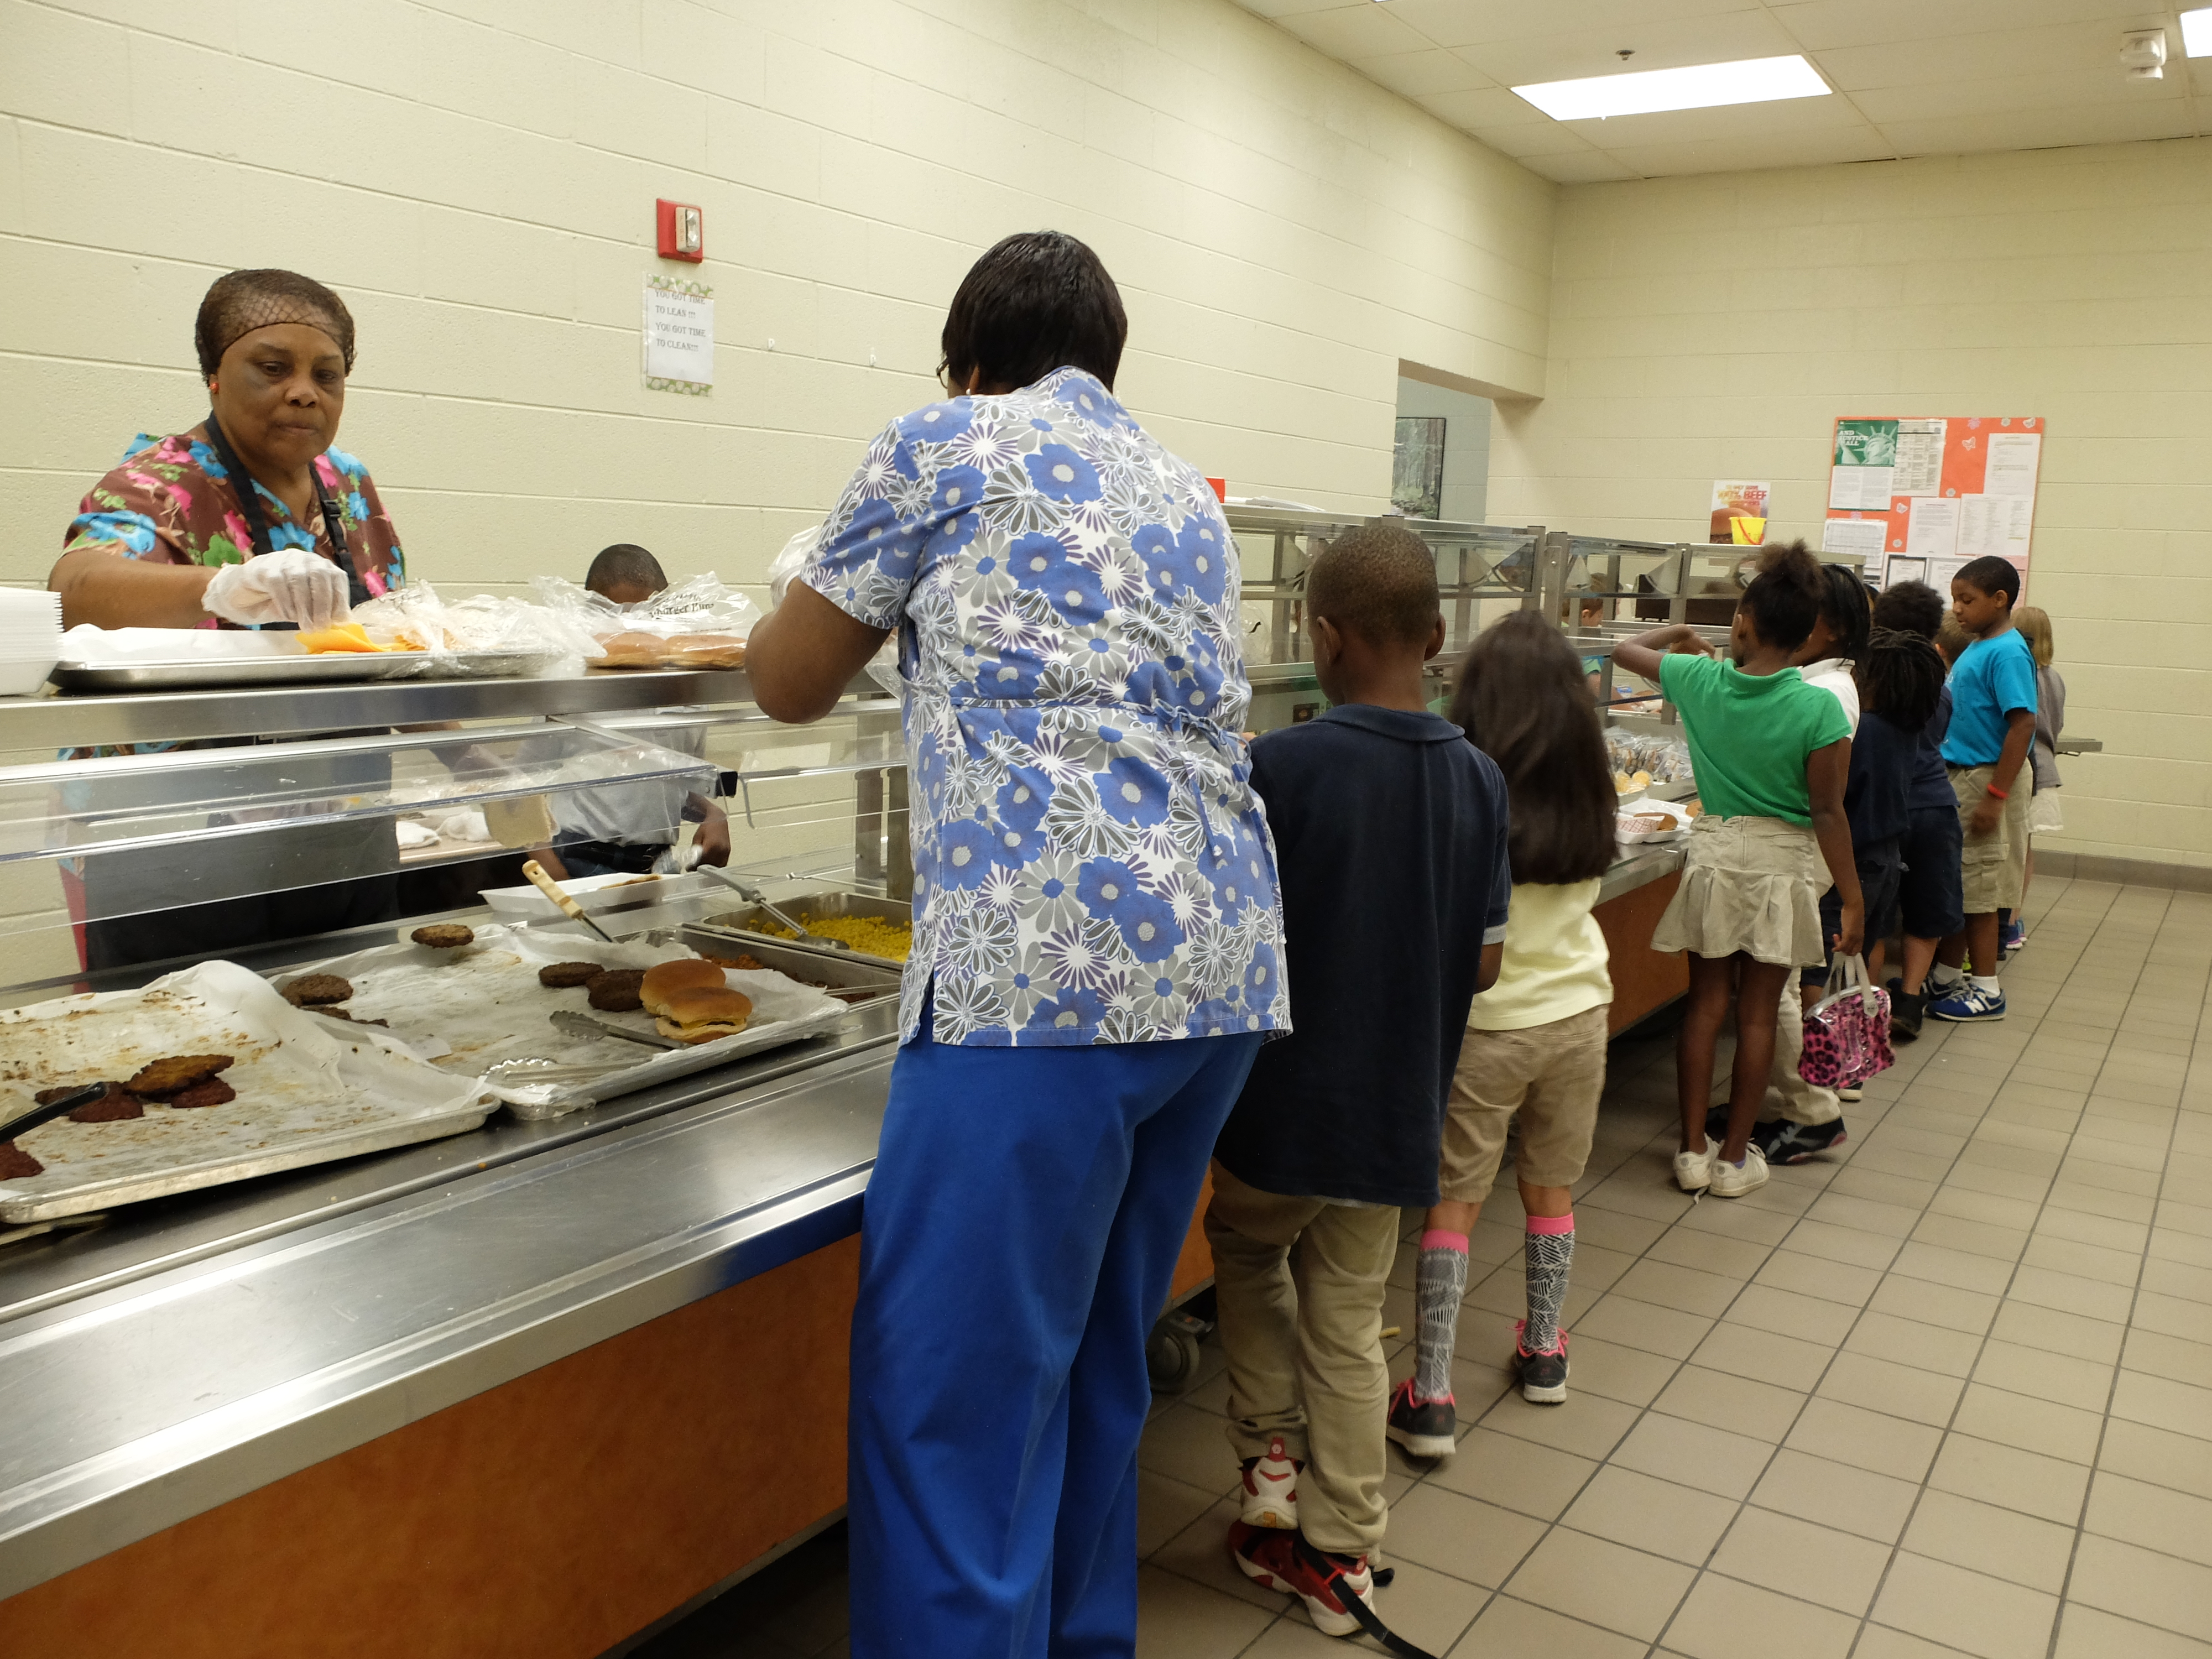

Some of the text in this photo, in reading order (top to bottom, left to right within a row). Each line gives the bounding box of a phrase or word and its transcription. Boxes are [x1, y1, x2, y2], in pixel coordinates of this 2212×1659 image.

[655, 289, 706, 305] YOU GOT TIME
[655, 305, 665, 314] TO
[667, 307, 686, 317] LEAN
[655, 321, 706, 337] YOU GOT TIME
[656, 338, 666, 347] TO
[1744, 490, 1767, 500] BEEF
